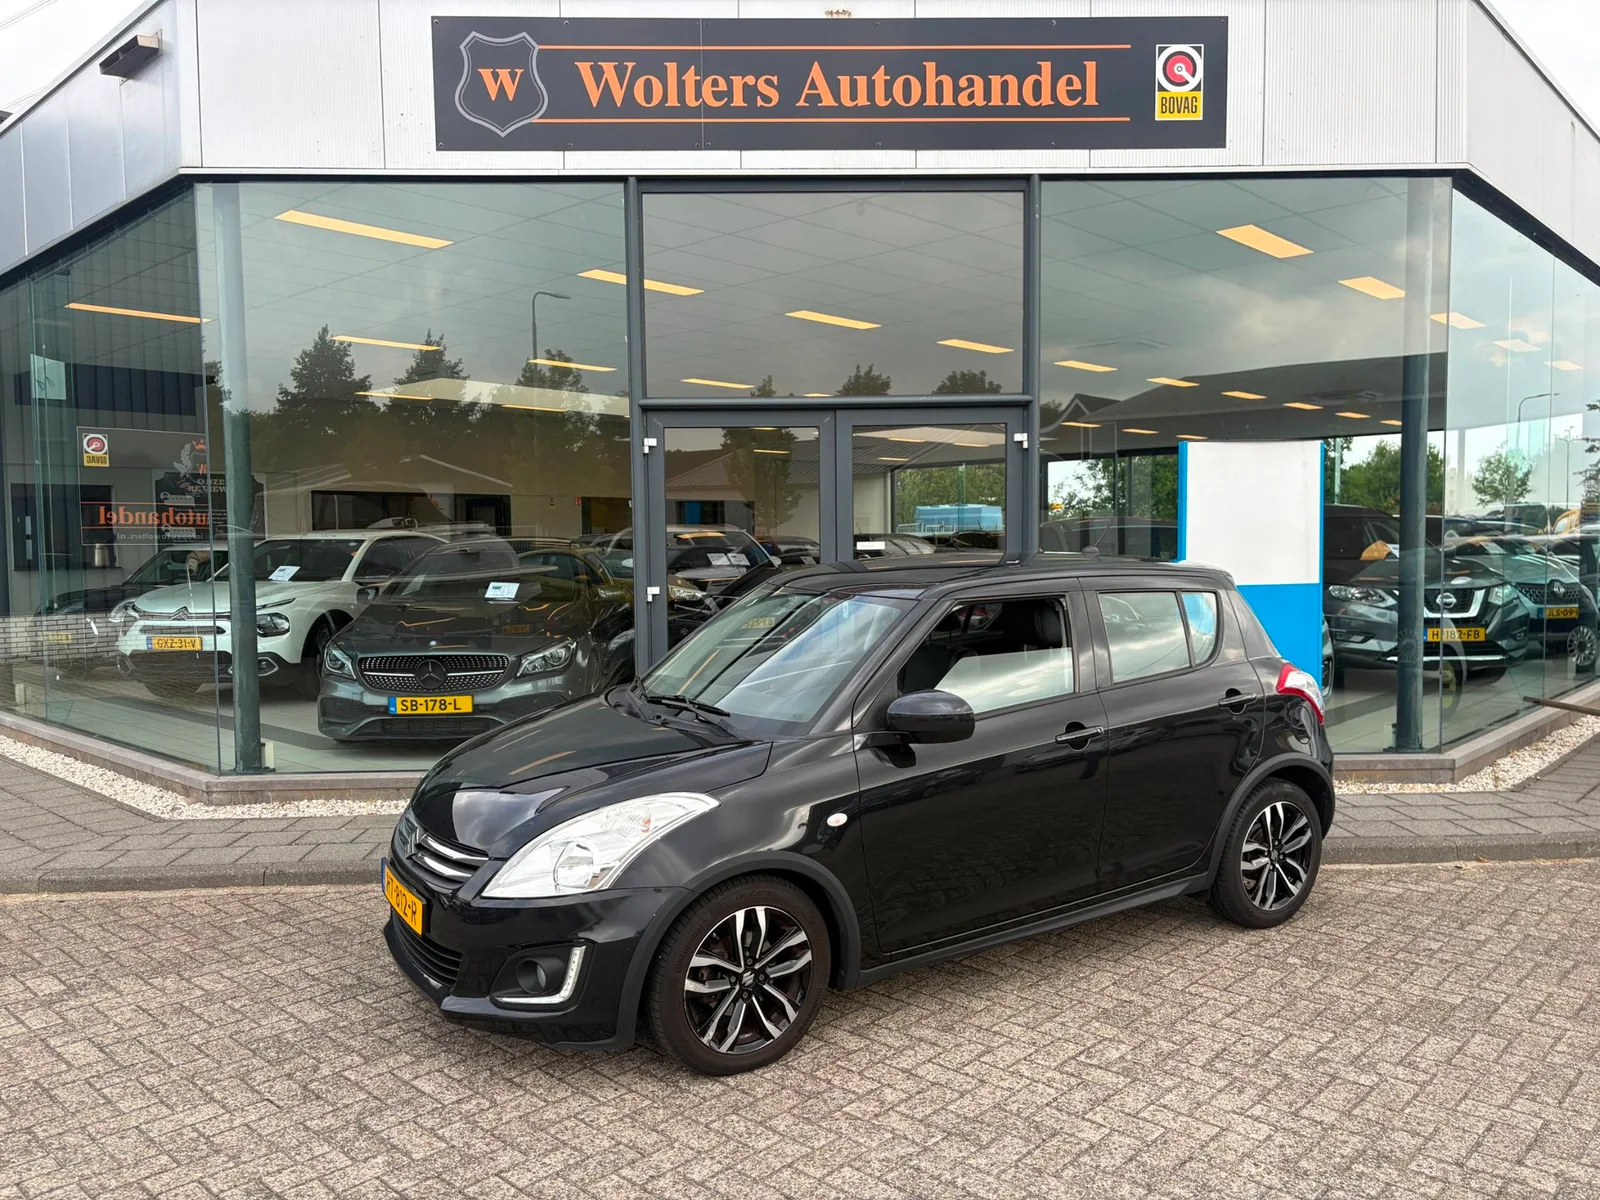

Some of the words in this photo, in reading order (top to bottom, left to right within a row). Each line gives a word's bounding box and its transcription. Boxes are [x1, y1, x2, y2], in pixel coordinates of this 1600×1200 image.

[477, 68, 525, 102] W
[574, 61, 780, 108] Wolters
[795, 61, 1099, 107] Autohandel
[1160, 96, 1198, 114] BOVAG
[157, 638, 196, 648] GXZ-31-V
[400, 698, 462, 712] SB-178-L
